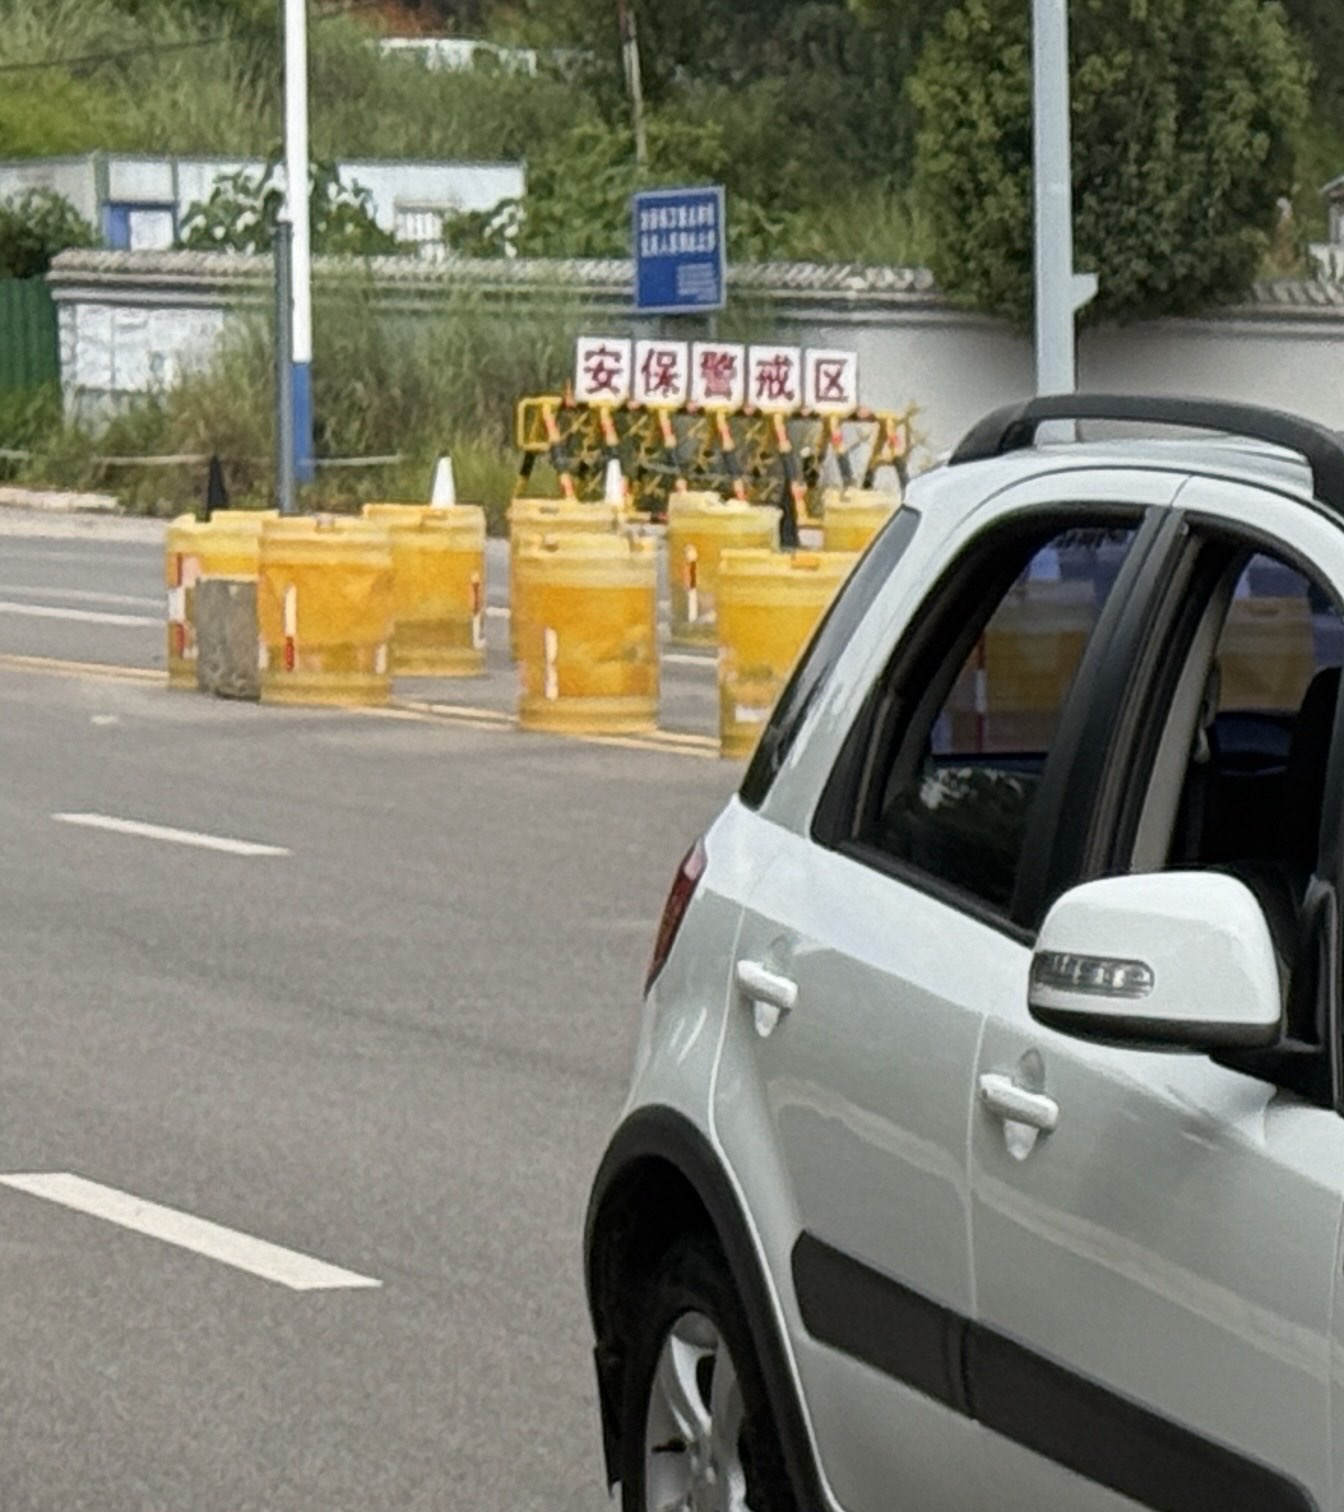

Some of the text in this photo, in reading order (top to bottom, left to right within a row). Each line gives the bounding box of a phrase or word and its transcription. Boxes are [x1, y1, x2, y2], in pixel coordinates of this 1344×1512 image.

[583, 344, 849, 402] 安保警戒区
